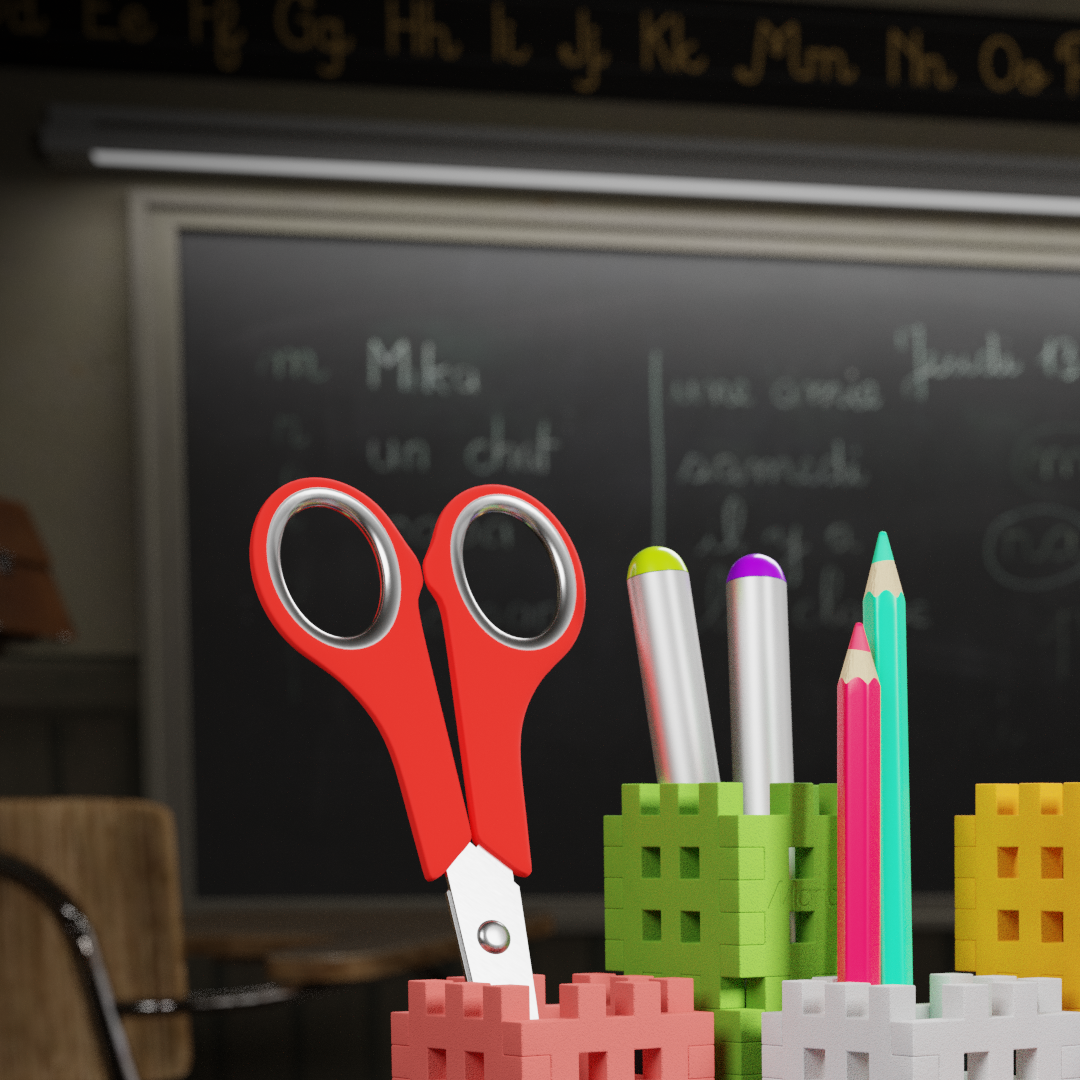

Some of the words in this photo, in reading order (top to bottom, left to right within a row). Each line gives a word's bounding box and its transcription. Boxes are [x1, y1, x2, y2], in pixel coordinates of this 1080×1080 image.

[273, 0, 356, 79] Gg
[383, 0, 464, 62] Hh
[639, 9, 709, 75] Kk
[732, 17, 860, 86] Mm
[885, 25, 957, 92] Nn
[977, 32, 1053, 97] Oo
[365, 435, 432, 475] un
